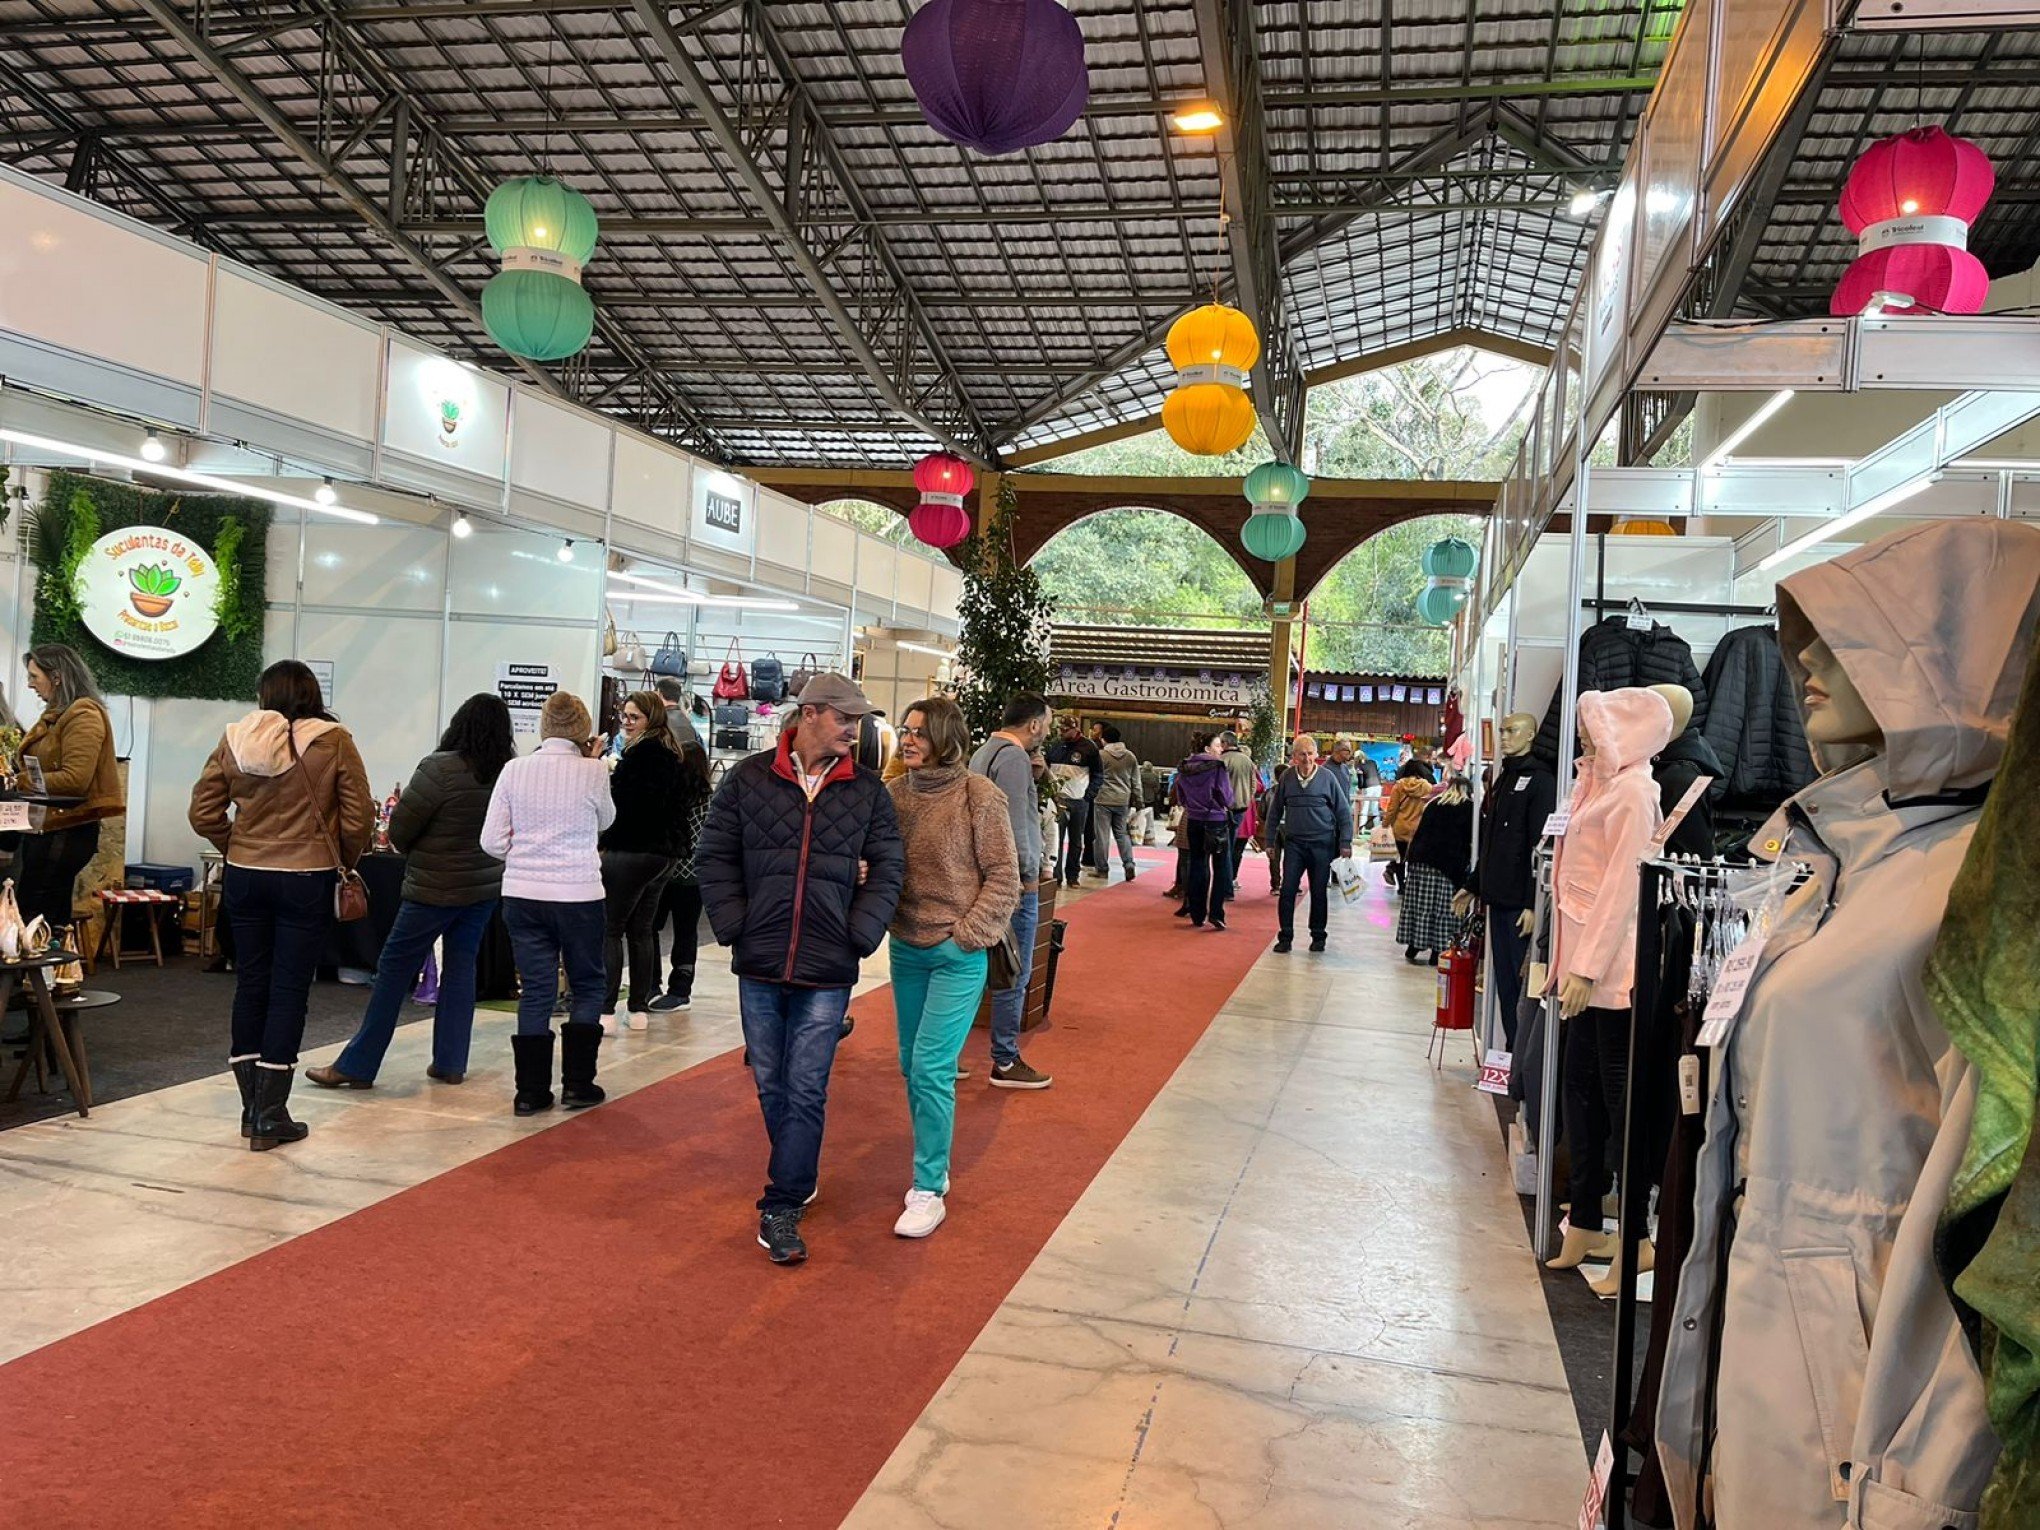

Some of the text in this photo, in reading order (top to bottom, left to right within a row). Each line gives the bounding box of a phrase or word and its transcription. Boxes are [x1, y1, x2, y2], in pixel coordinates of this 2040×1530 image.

[707, 497, 738, 527] AUBE
[105, 534, 168, 559] Suculentas
[1103, 679, 1239, 702] Gastronômica
[1483, 1069, 1510, 1086] 12X
